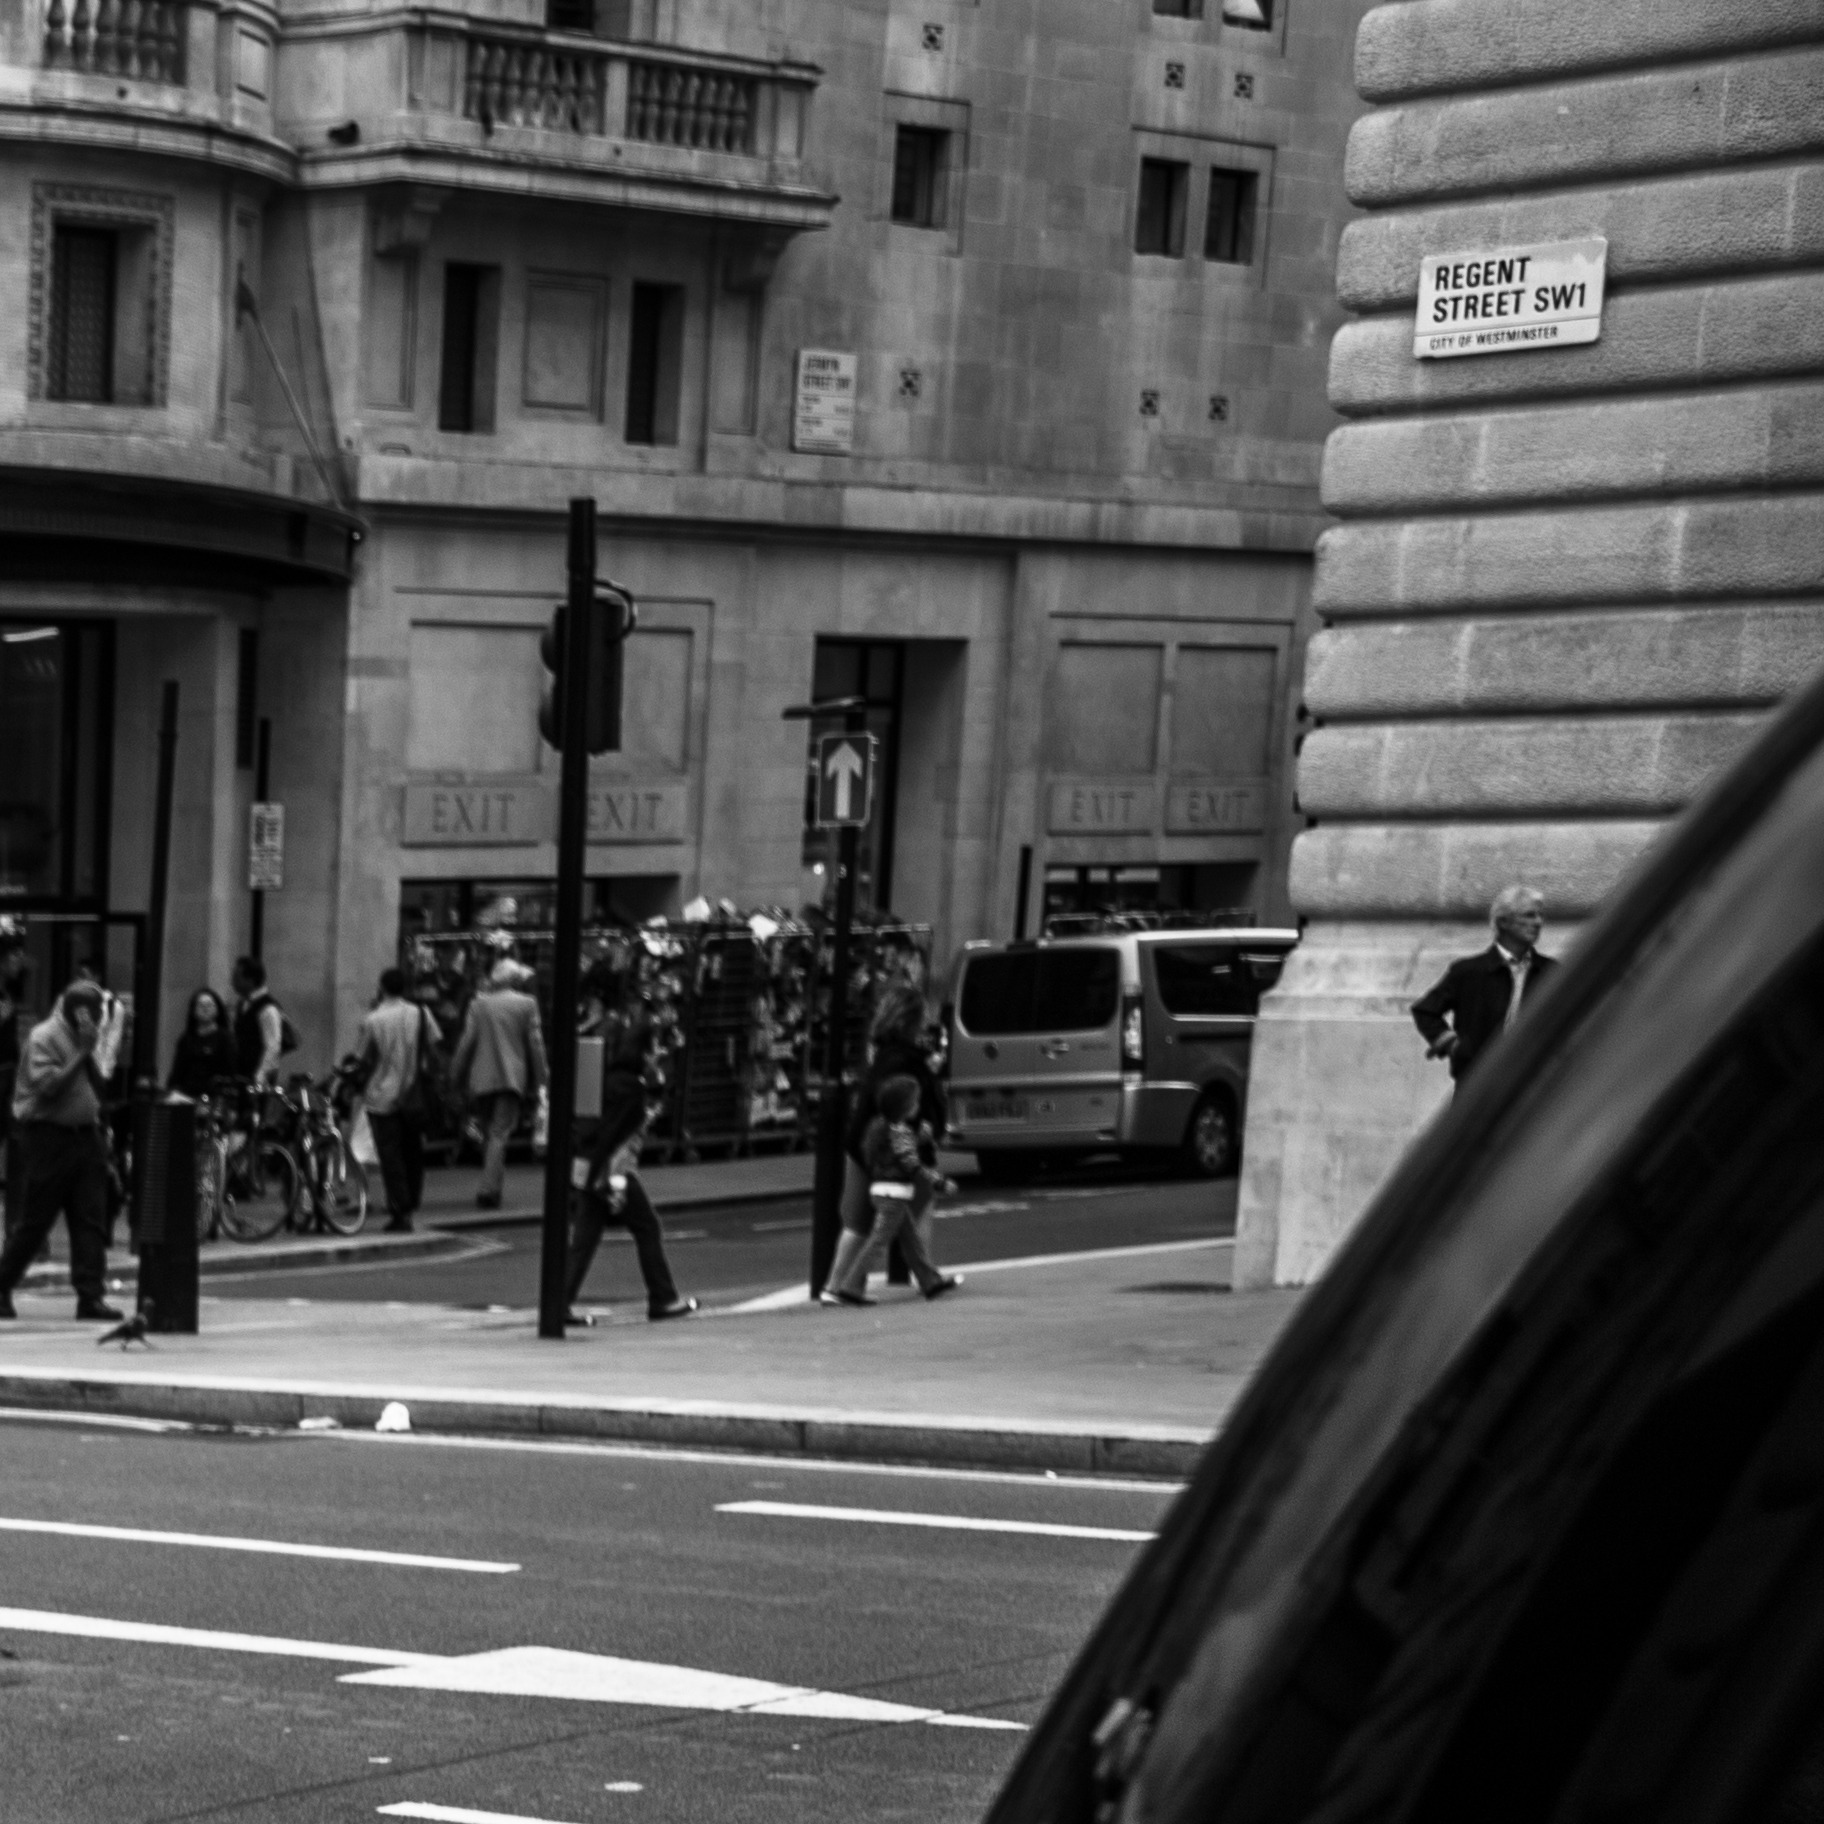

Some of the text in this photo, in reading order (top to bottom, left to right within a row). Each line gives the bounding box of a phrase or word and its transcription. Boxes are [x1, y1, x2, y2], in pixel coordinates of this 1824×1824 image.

[1435, 256, 1531, 291] REGENT
[1432, 282, 1586, 323] STREET SW1
[1429, 326, 1559, 350] CITY OF WESTMINSTER
[432, 793, 515, 833] EXIT
[586, 792, 664, 831] EXIT
[1071, 790, 1135, 823] EXIT
